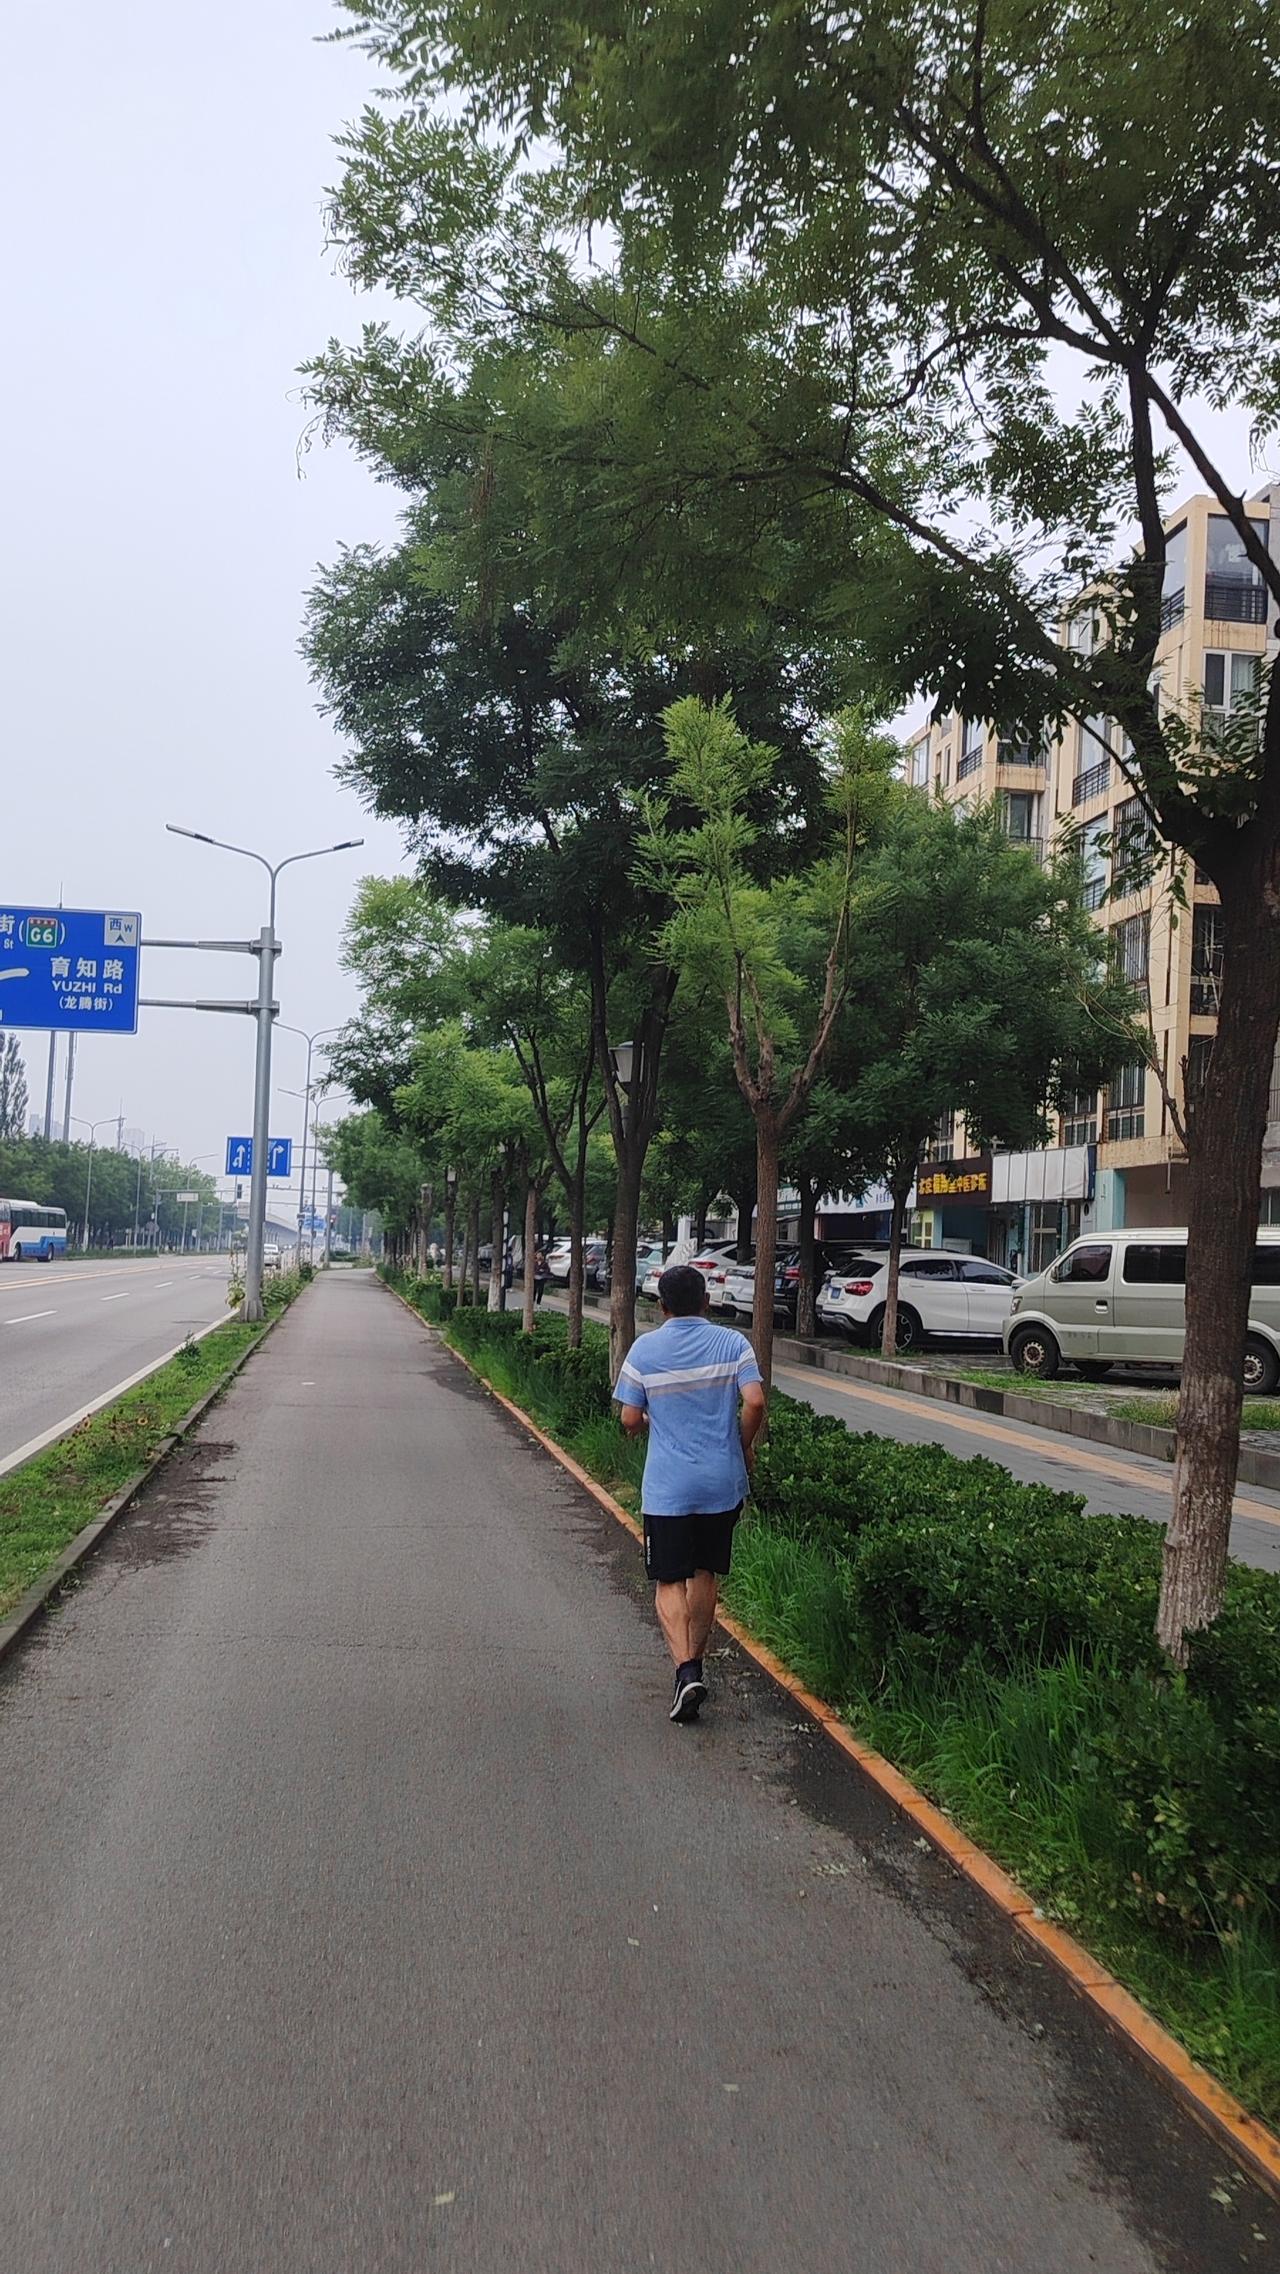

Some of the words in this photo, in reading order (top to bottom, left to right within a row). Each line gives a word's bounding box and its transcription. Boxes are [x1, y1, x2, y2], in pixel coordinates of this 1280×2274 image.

[109, 918, 122, 931] 西
[124, 924, 133, 933] W
[50, 956, 124, 980] 育知路
[52, 980, 96, 993] YUZHI
[104, 983, 122, 994] Rd
